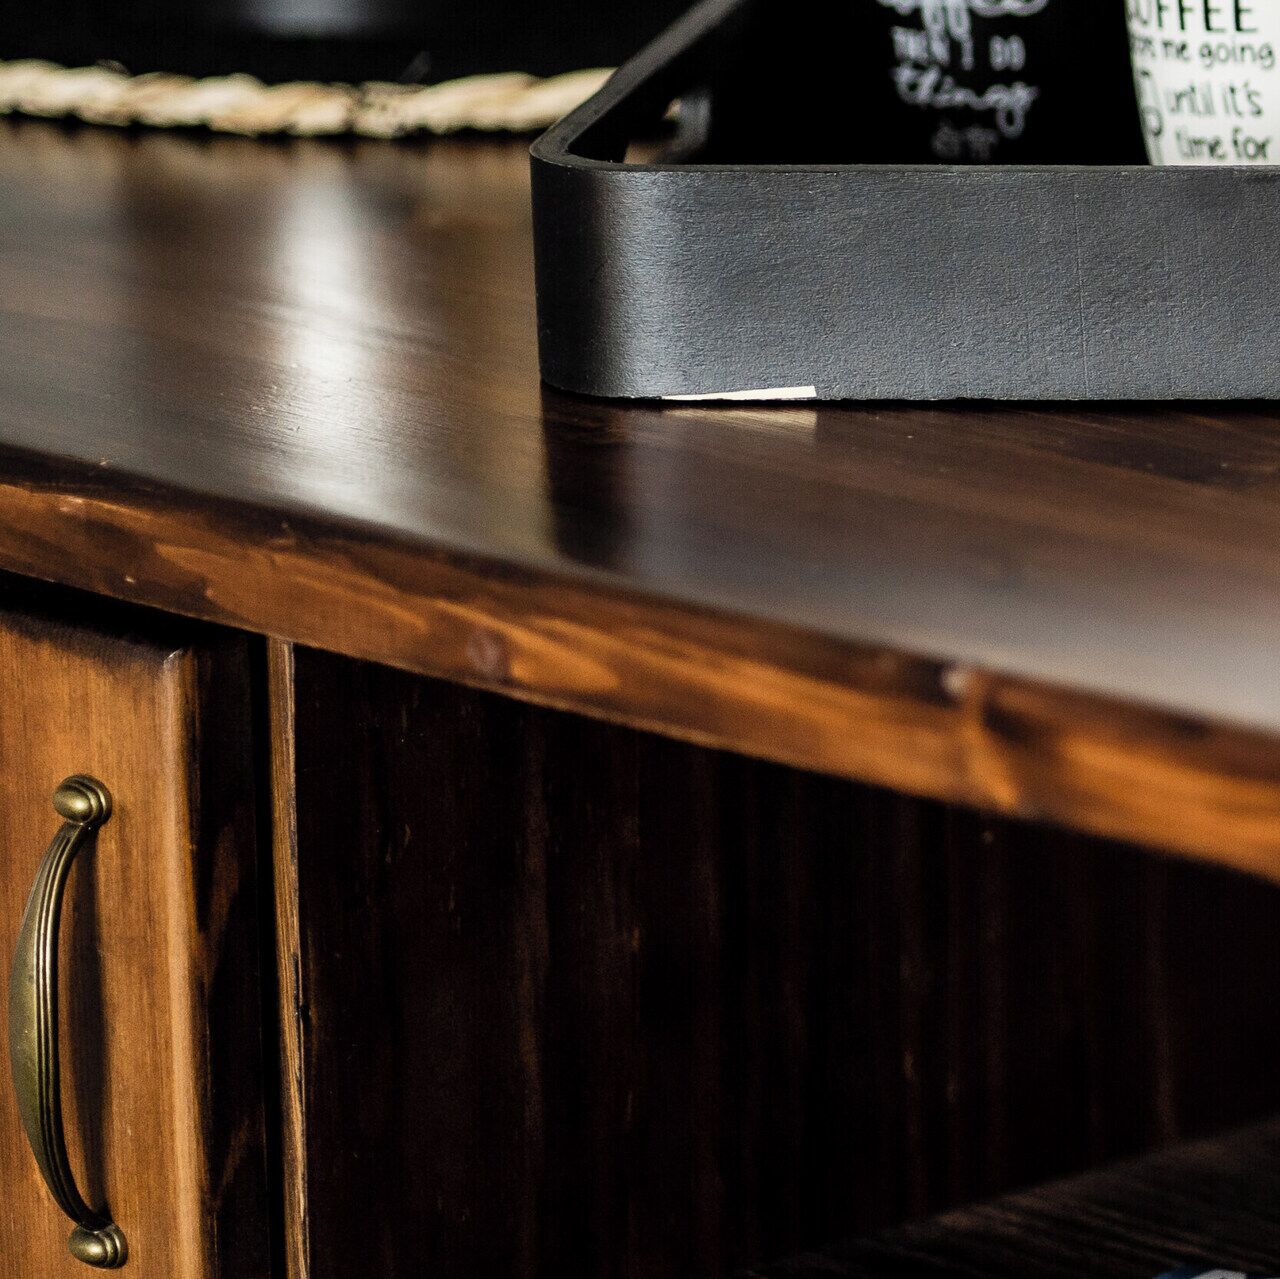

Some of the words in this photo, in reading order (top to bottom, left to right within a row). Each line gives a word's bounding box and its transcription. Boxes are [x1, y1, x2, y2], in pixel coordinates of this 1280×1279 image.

[989, 34, 1026, 70] DO
[1199, 39, 1275, 70] going
[1232, 126, 1270, 160] for
